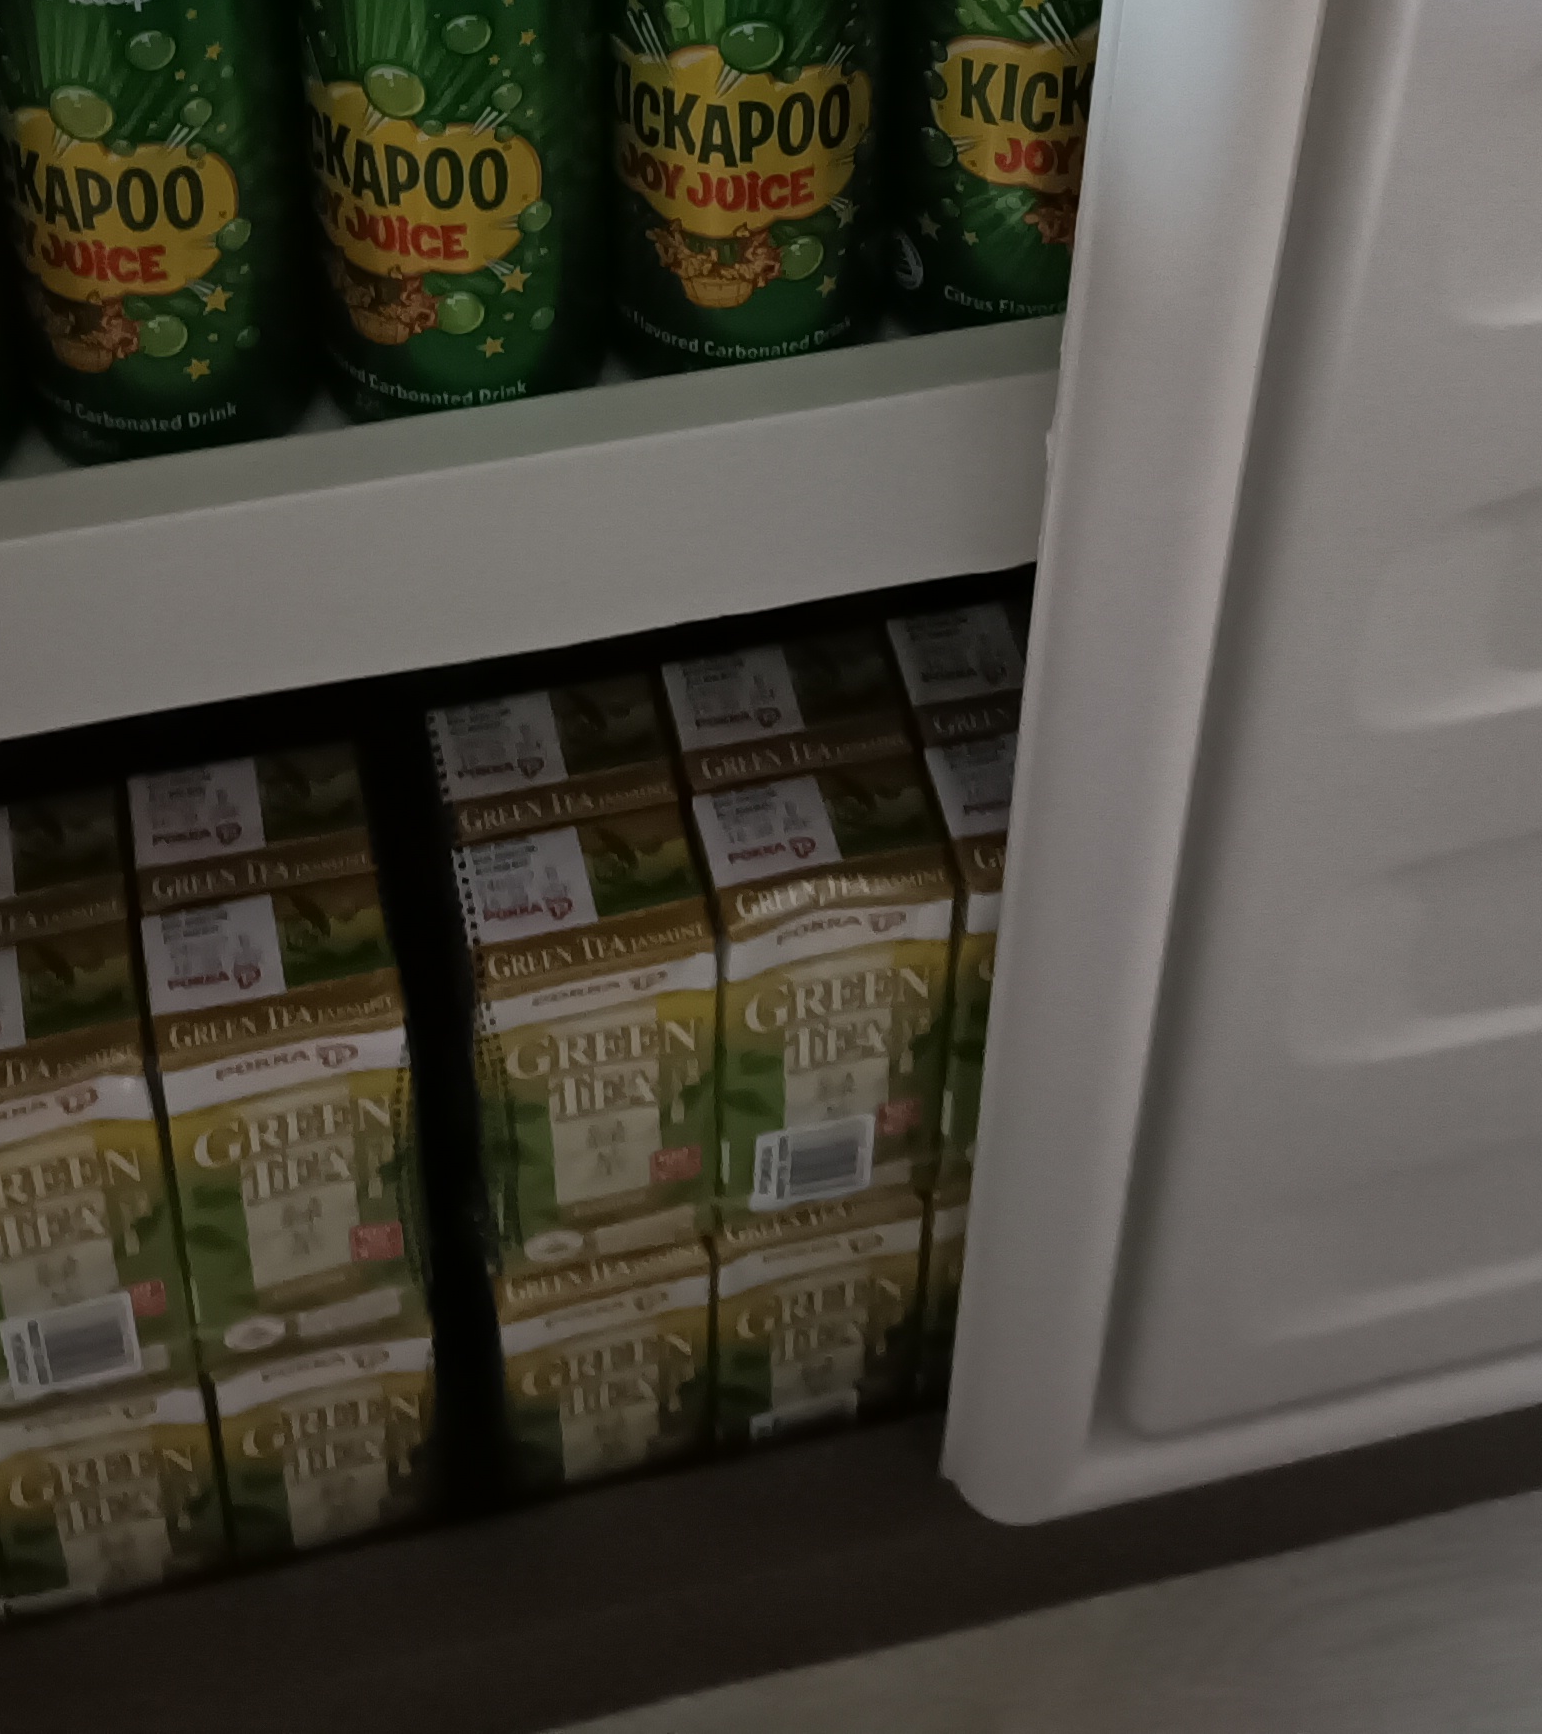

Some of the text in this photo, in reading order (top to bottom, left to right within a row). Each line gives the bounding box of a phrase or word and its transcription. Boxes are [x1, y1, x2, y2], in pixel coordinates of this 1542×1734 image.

[616, 65, 850, 168] ICKAPOO
[960, 58, 1096, 133] KICK
[622, 142, 815, 213] JOY JUICE
[994, 137, 1080, 175] JOY
[41, 233, 167, 284] JUICE
[345, 208, 469, 261] JUICE
[999, 299, 1067, 315] Flavor
[704, 334, 810, 361] Carbonated
[370, 370, 528, 406] Carbonated Drink
[74, 401, 238, 432] Carbonated Drink
[745, 967, 929, 1034] GREEN
[506, 1019, 696, 1080] GREEN
[787, 1022, 887, 1068] TEA
[553, 1069, 656, 1116] TEA
[194, 1095, 391, 1168] GREEN
[243, 1147, 351, 1200] TEA
